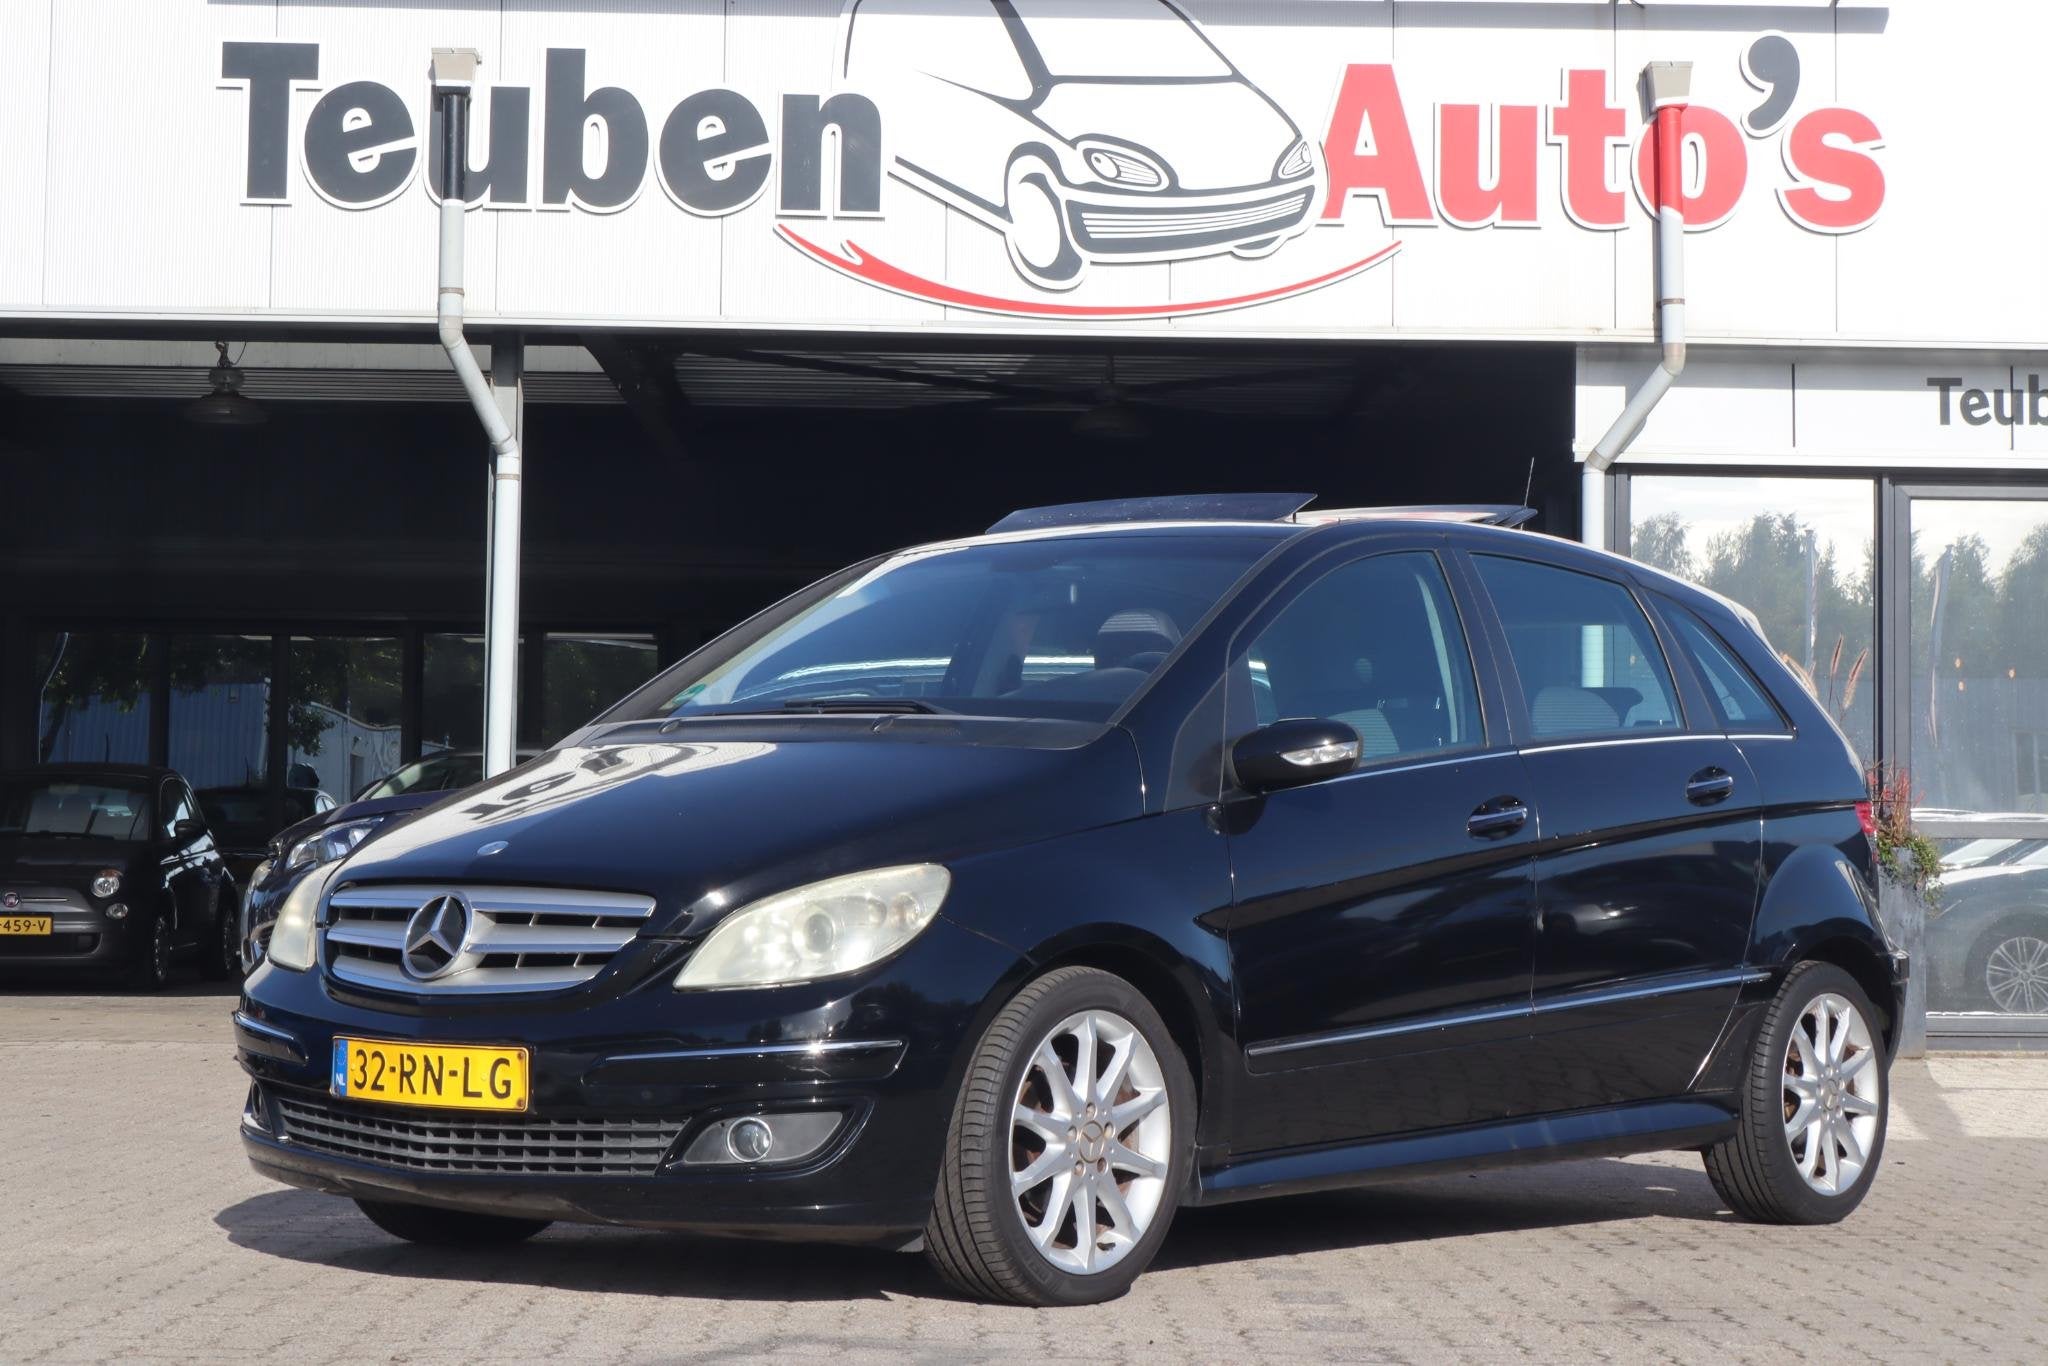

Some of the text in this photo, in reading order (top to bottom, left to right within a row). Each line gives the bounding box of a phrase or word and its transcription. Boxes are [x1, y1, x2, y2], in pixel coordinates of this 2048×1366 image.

[221, 35, 1886, 228] Teuben Auto's
[1927, 374, 2048, 426] Teub
[335, 1072, 346, 1086] NL
[354, 1049, 511, 1099] 32-RN-LG
